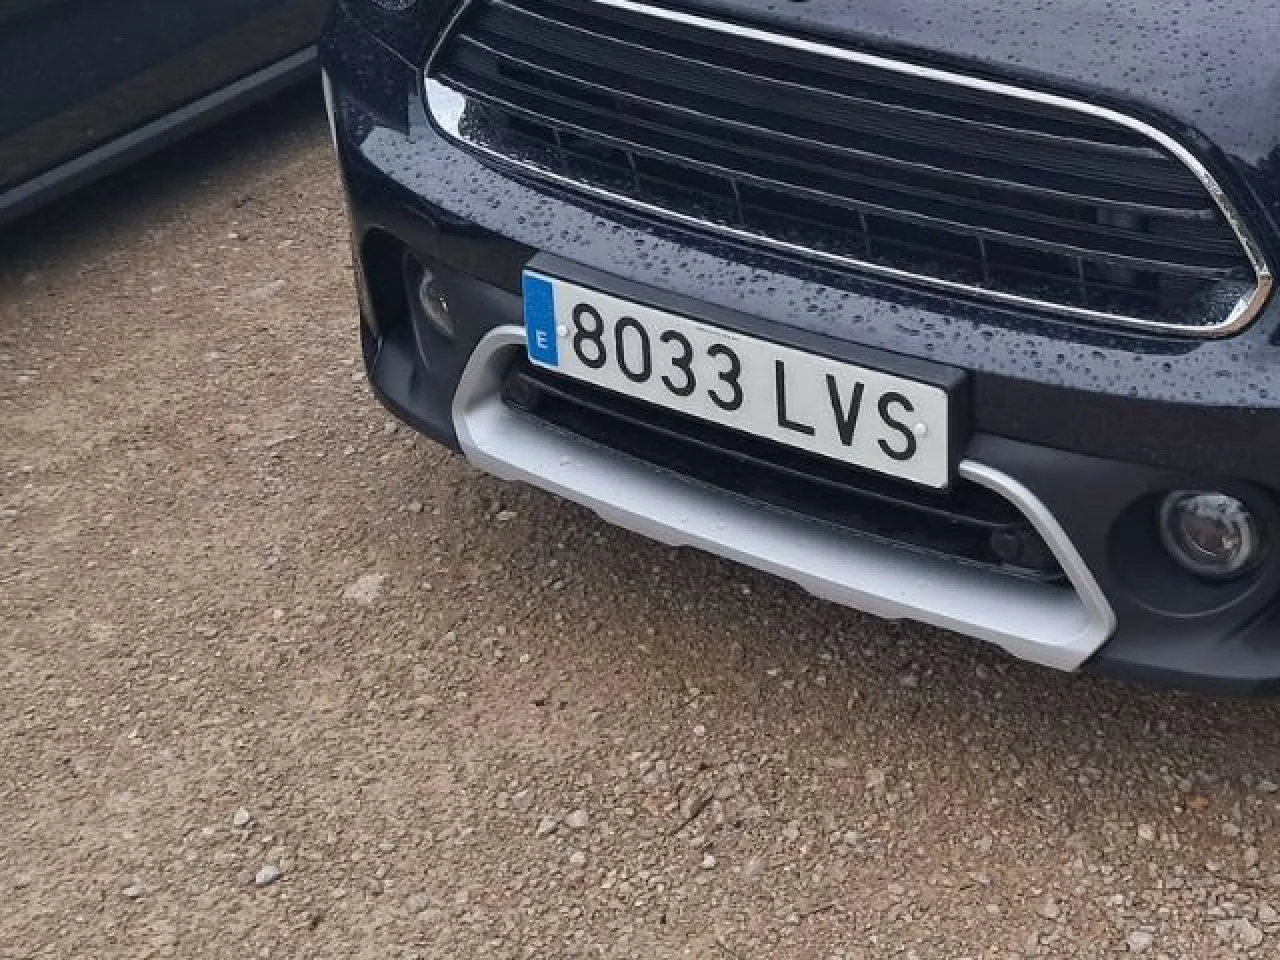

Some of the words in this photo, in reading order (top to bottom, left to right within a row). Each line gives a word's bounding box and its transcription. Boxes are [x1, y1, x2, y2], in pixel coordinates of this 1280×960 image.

[536, 331, 548, 350] E
[571, 302, 744, 411] 8033
[775, 358, 917, 461] LVS
